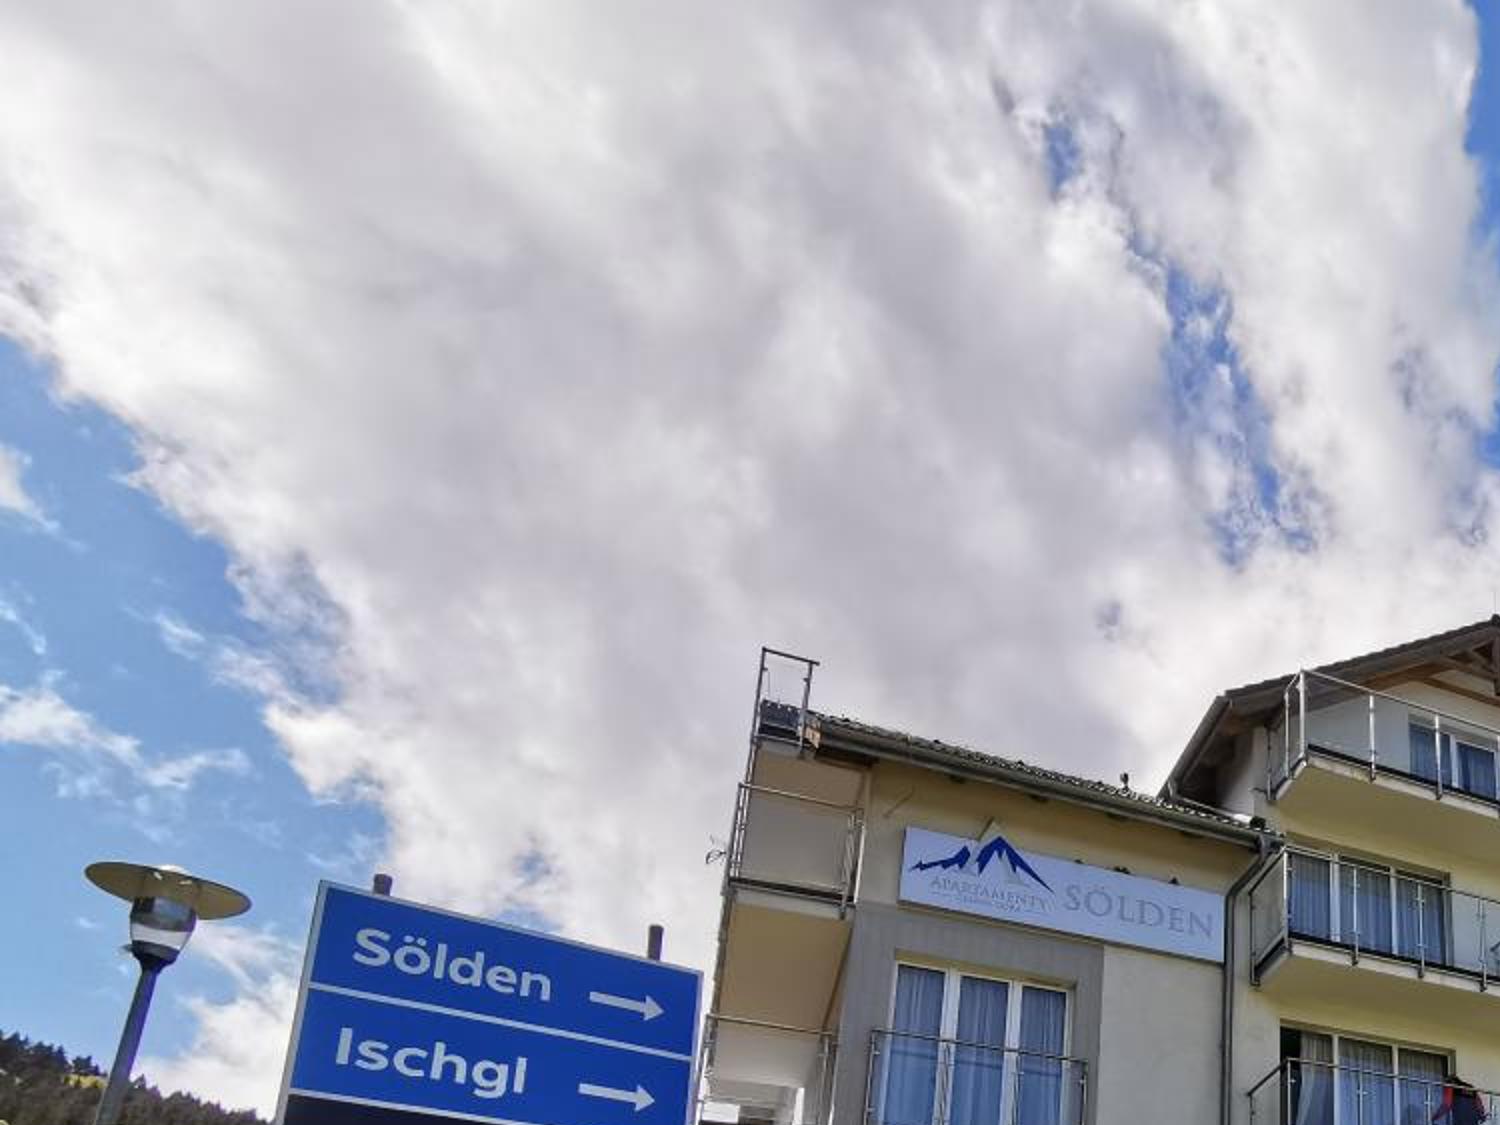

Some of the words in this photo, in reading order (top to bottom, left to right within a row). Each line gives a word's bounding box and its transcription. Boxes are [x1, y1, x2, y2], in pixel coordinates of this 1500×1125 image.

[1063, 884, 1214, 939] SÖLDEN
[352, 928, 552, 1002] Sölden
[335, 1026, 527, 1100] Ischgl
